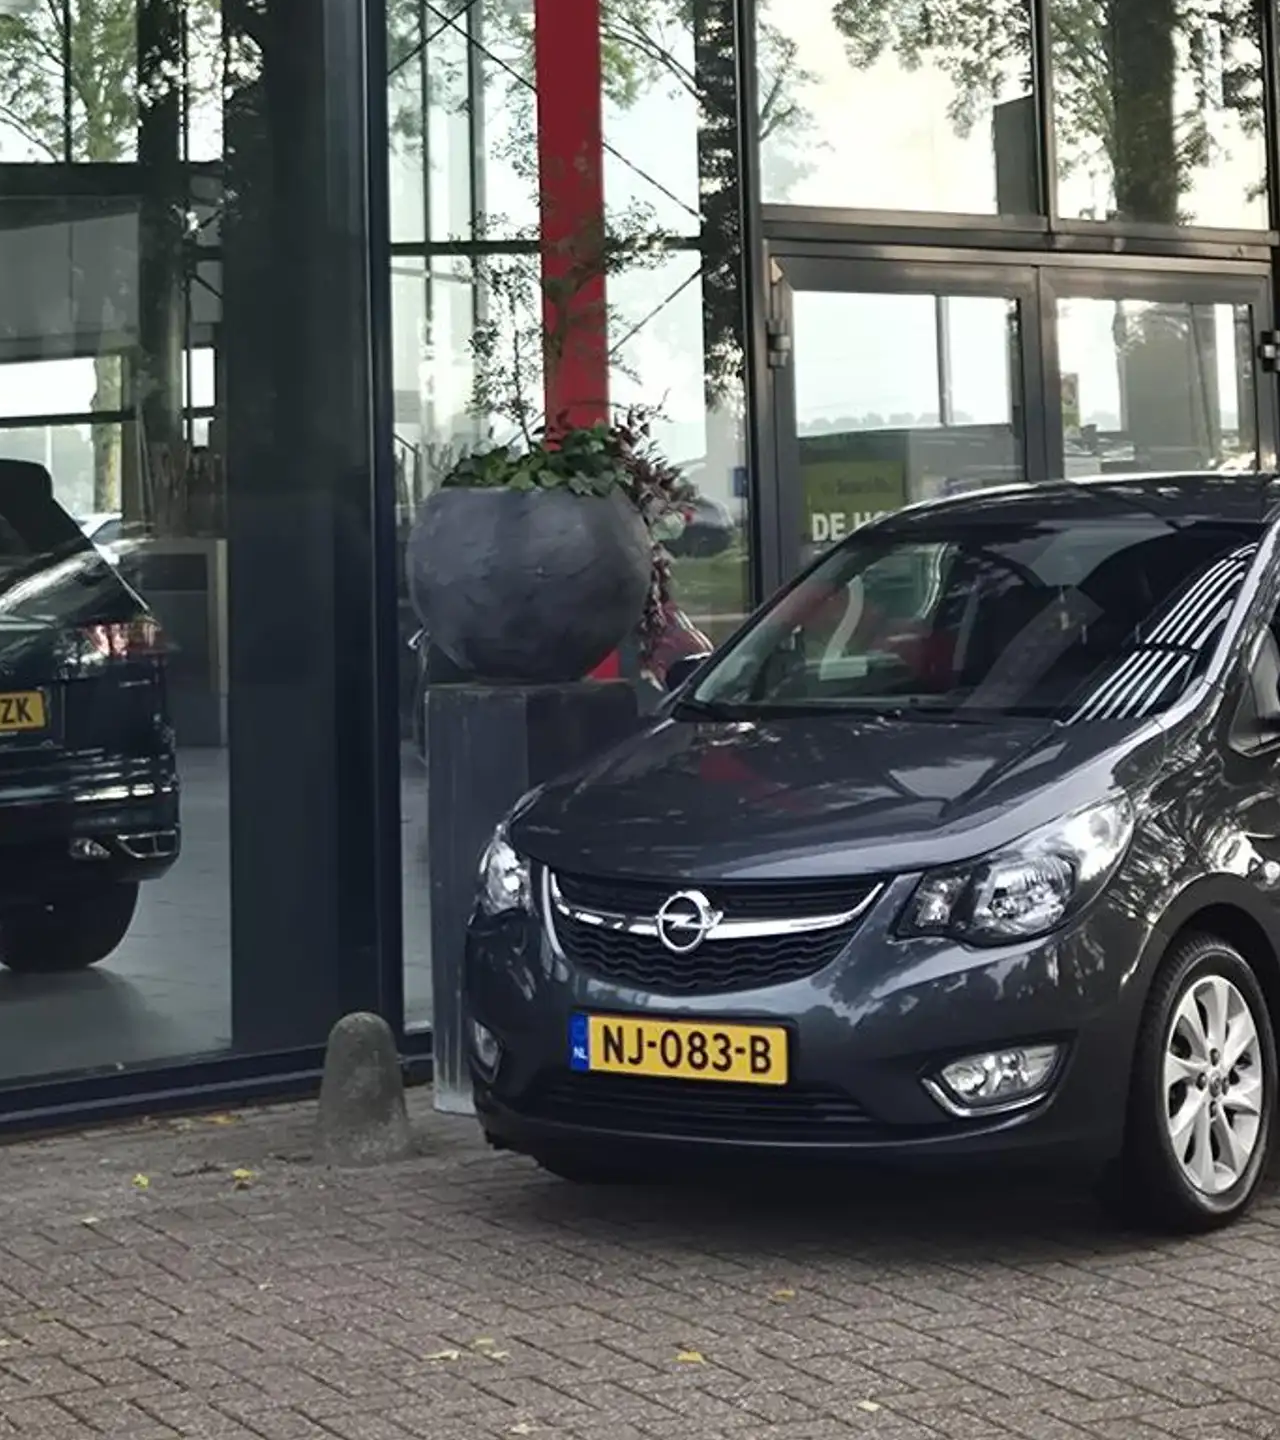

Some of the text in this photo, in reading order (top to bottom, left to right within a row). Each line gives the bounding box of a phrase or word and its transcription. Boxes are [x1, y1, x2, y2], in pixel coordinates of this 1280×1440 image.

[812, 512, 846, 541] DE
[573, 1024, 773, 1075] NL NJ-083-B
